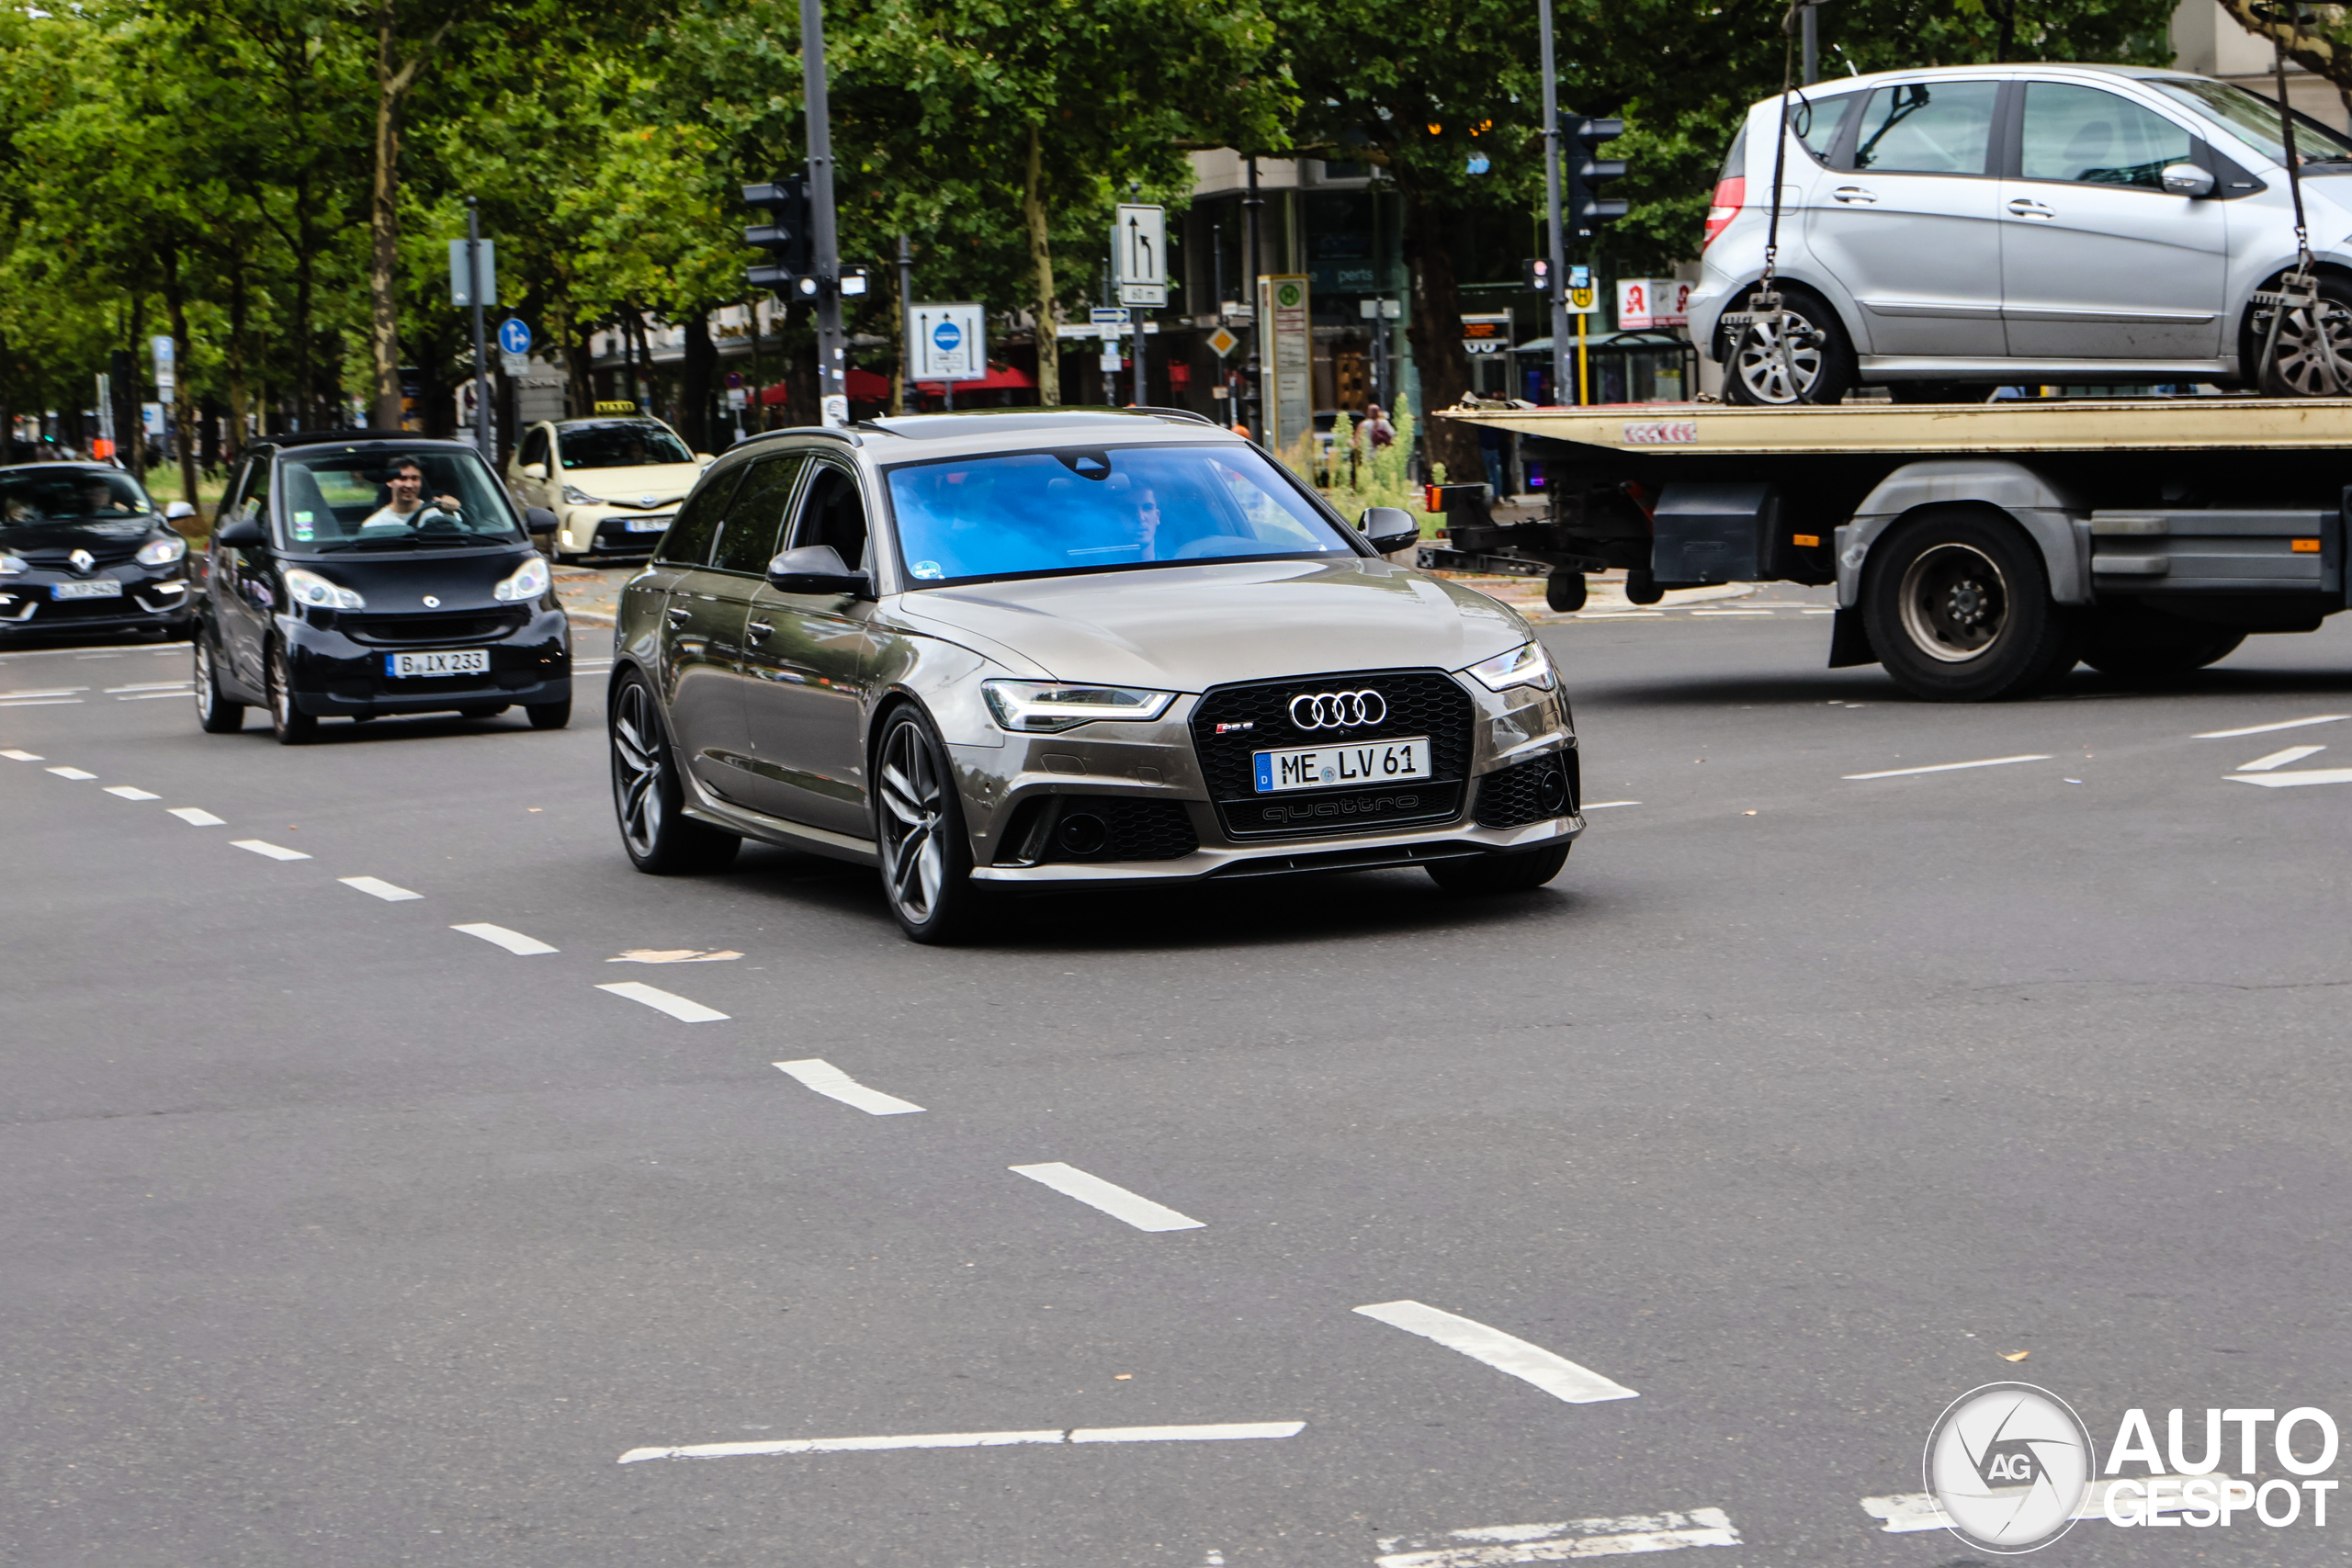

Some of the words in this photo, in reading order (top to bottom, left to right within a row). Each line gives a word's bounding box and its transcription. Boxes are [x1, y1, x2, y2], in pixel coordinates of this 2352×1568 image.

[1146, 291, 1157, 300] m
[402, 656, 413, 671] B
[426, 655, 447, 671] IX
[451, 653, 481, 670] 233
[1282, 753, 1319, 784] ME
[1339, 749, 1374, 779] LV
[1384, 745, 1416, 774] 61
[1261, 775, 1269, 784] D
[1262, 795, 1419, 823] quattro
